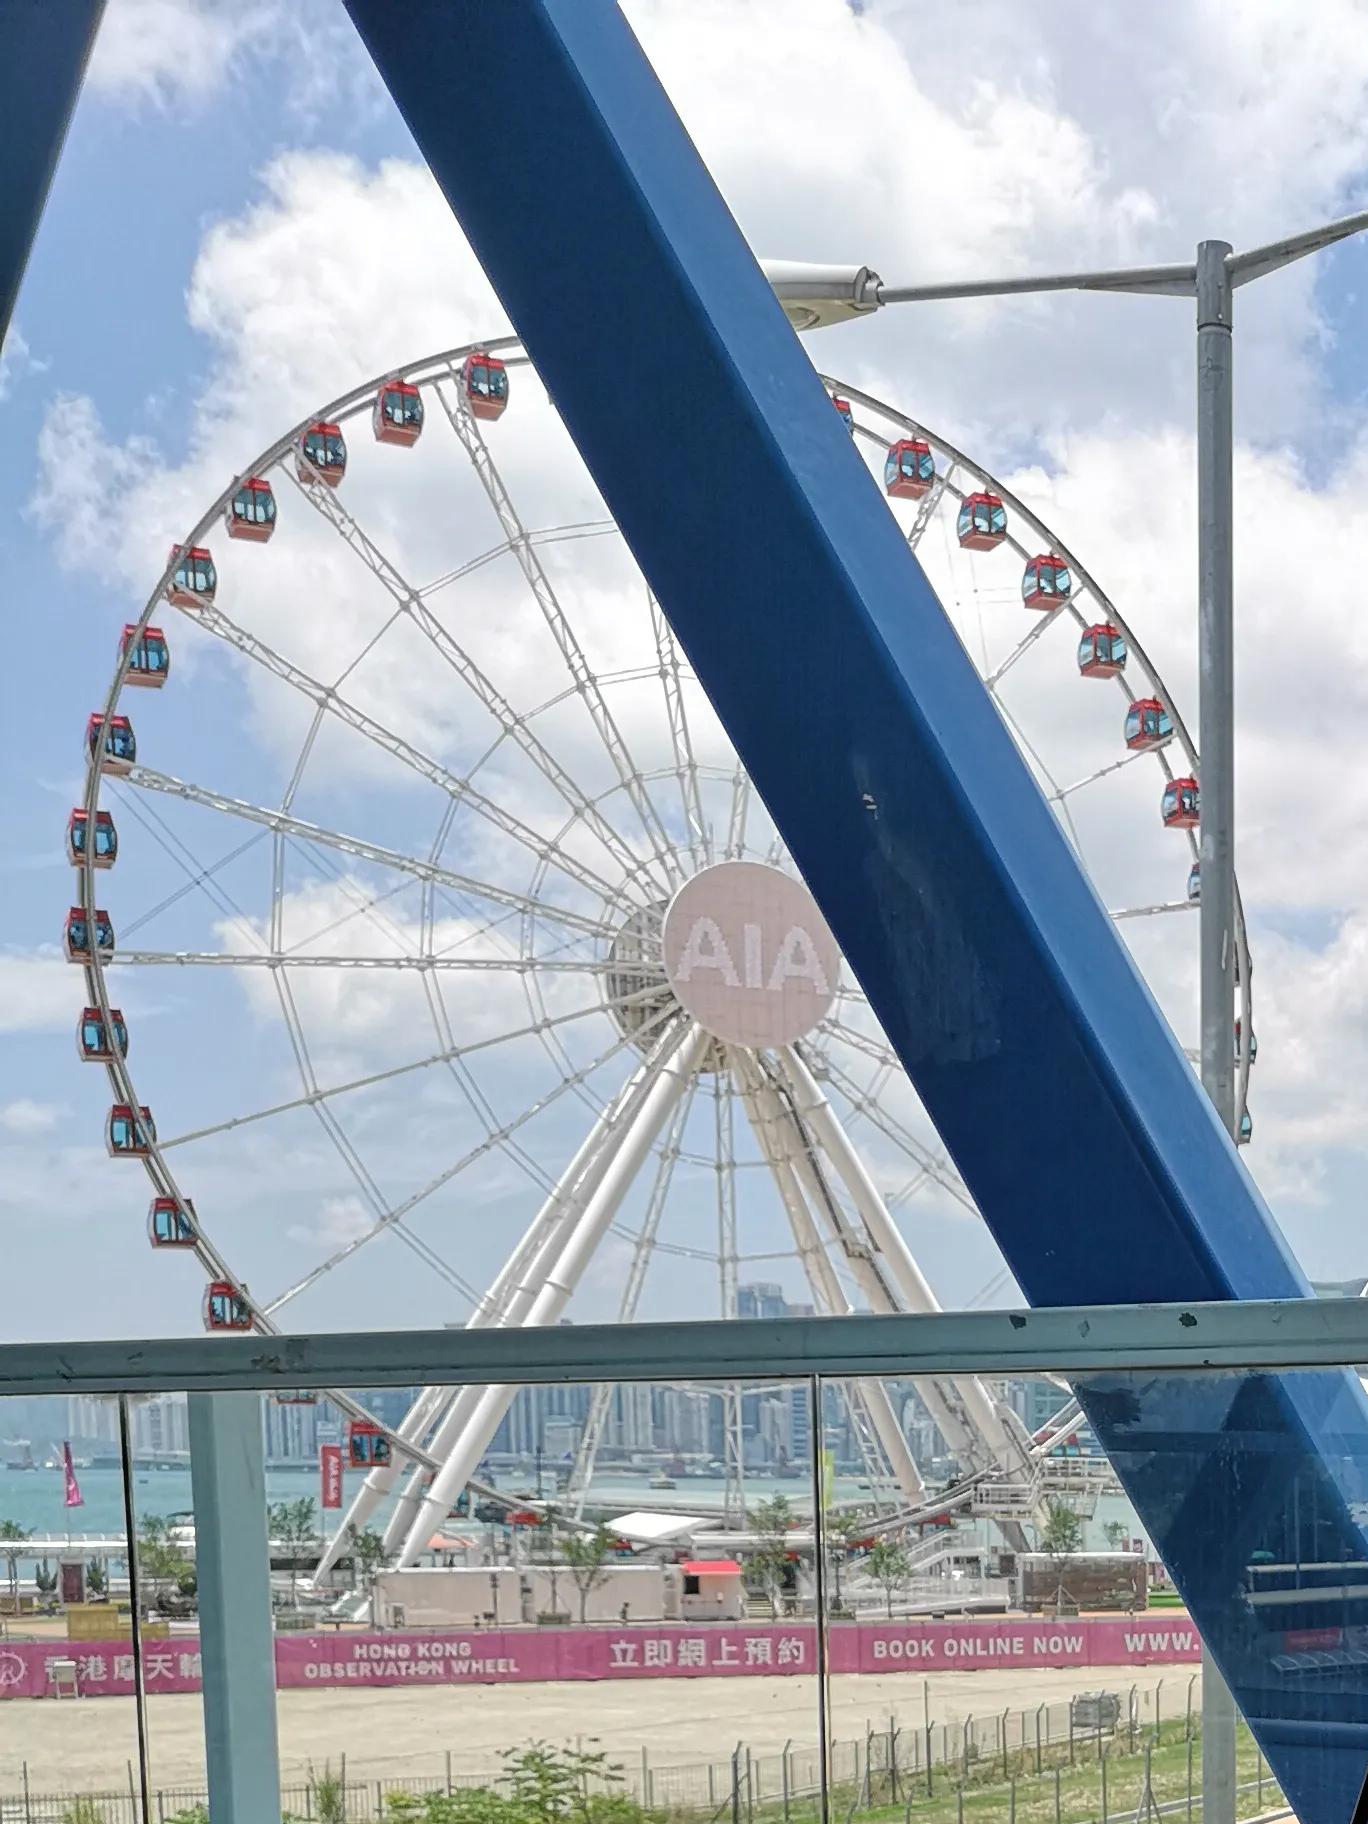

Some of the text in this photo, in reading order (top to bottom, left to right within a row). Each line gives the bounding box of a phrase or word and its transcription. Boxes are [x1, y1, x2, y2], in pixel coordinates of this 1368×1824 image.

[675, 916, 829, 995] AIA
[354, 1641, 472, 1660] HONG KONG
[610, 1637, 805, 1669] 立即網上預約
[873, 1635, 1084, 1660] BOOK ONLINE NOW
[304, 1657, 520, 1679] OBSERVATION WHEEL
